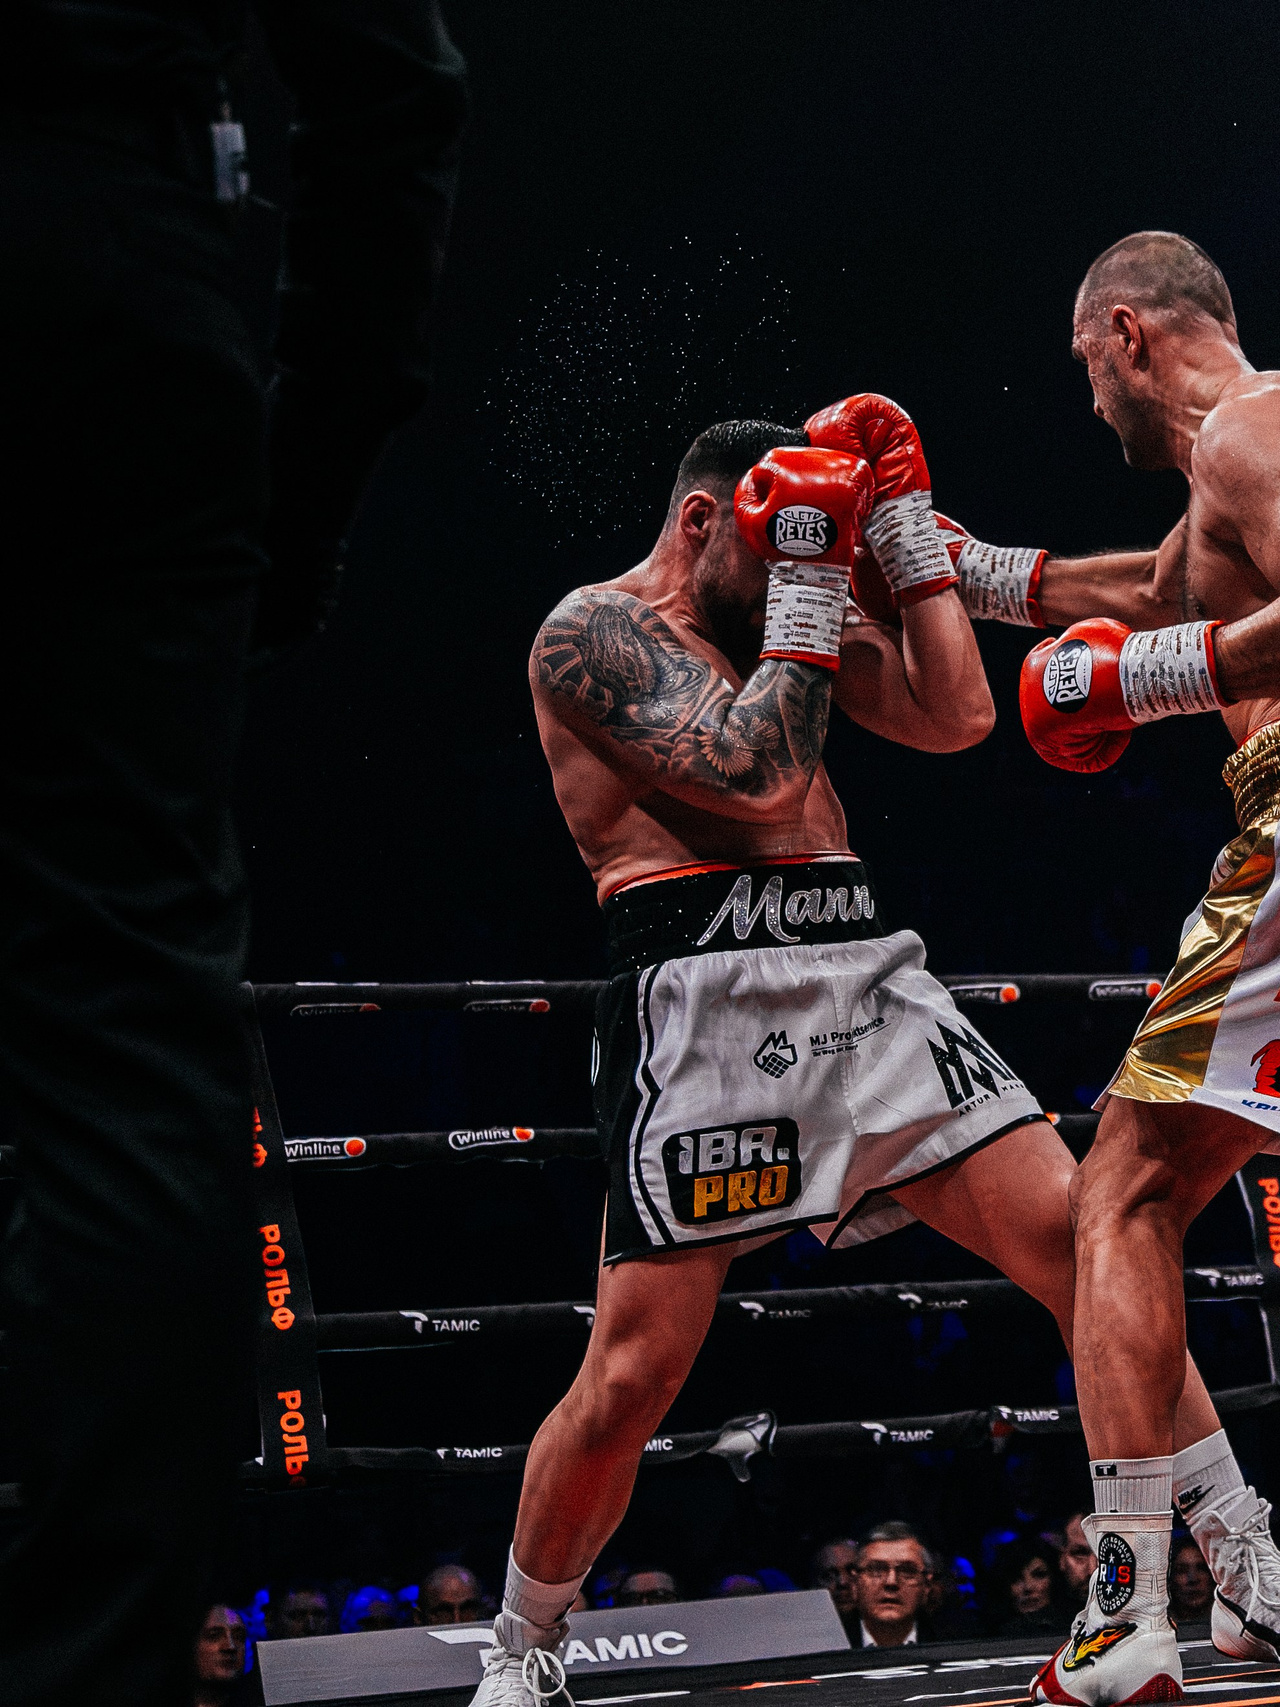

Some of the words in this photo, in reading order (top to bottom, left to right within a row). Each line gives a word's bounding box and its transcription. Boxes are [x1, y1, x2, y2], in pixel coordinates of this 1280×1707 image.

[776, 517, 827, 546] REYES
[1056, 648, 1085, 703] REYES
[696, 874, 875, 946] Mann
[809, 1033, 828, 1046] MJ
[959, 1093, 991, 1117] ARTUR
[456, 1128, 510, 1145] Winline
[285, 1142, 341, 1157] Winline
[694, 1165, 789, 1218] PRO
[259, 1224, 296, 1331] РОЛЬФ
[432, 1319, 481, 1332] TAMIC
[1014, 1408, 1060, 1422] TAMIC
[643, 1438, 673, 1451] MIC
[889, 1430, 934, 1443] TAMIC
[453, 1447, 503, 1459] TAMIC
[1178, 1484, 1203, 1507] NIKE
[1098, 1563, 1131, 1584] RUS
[560, 1631, 688, 1665] AMIC
